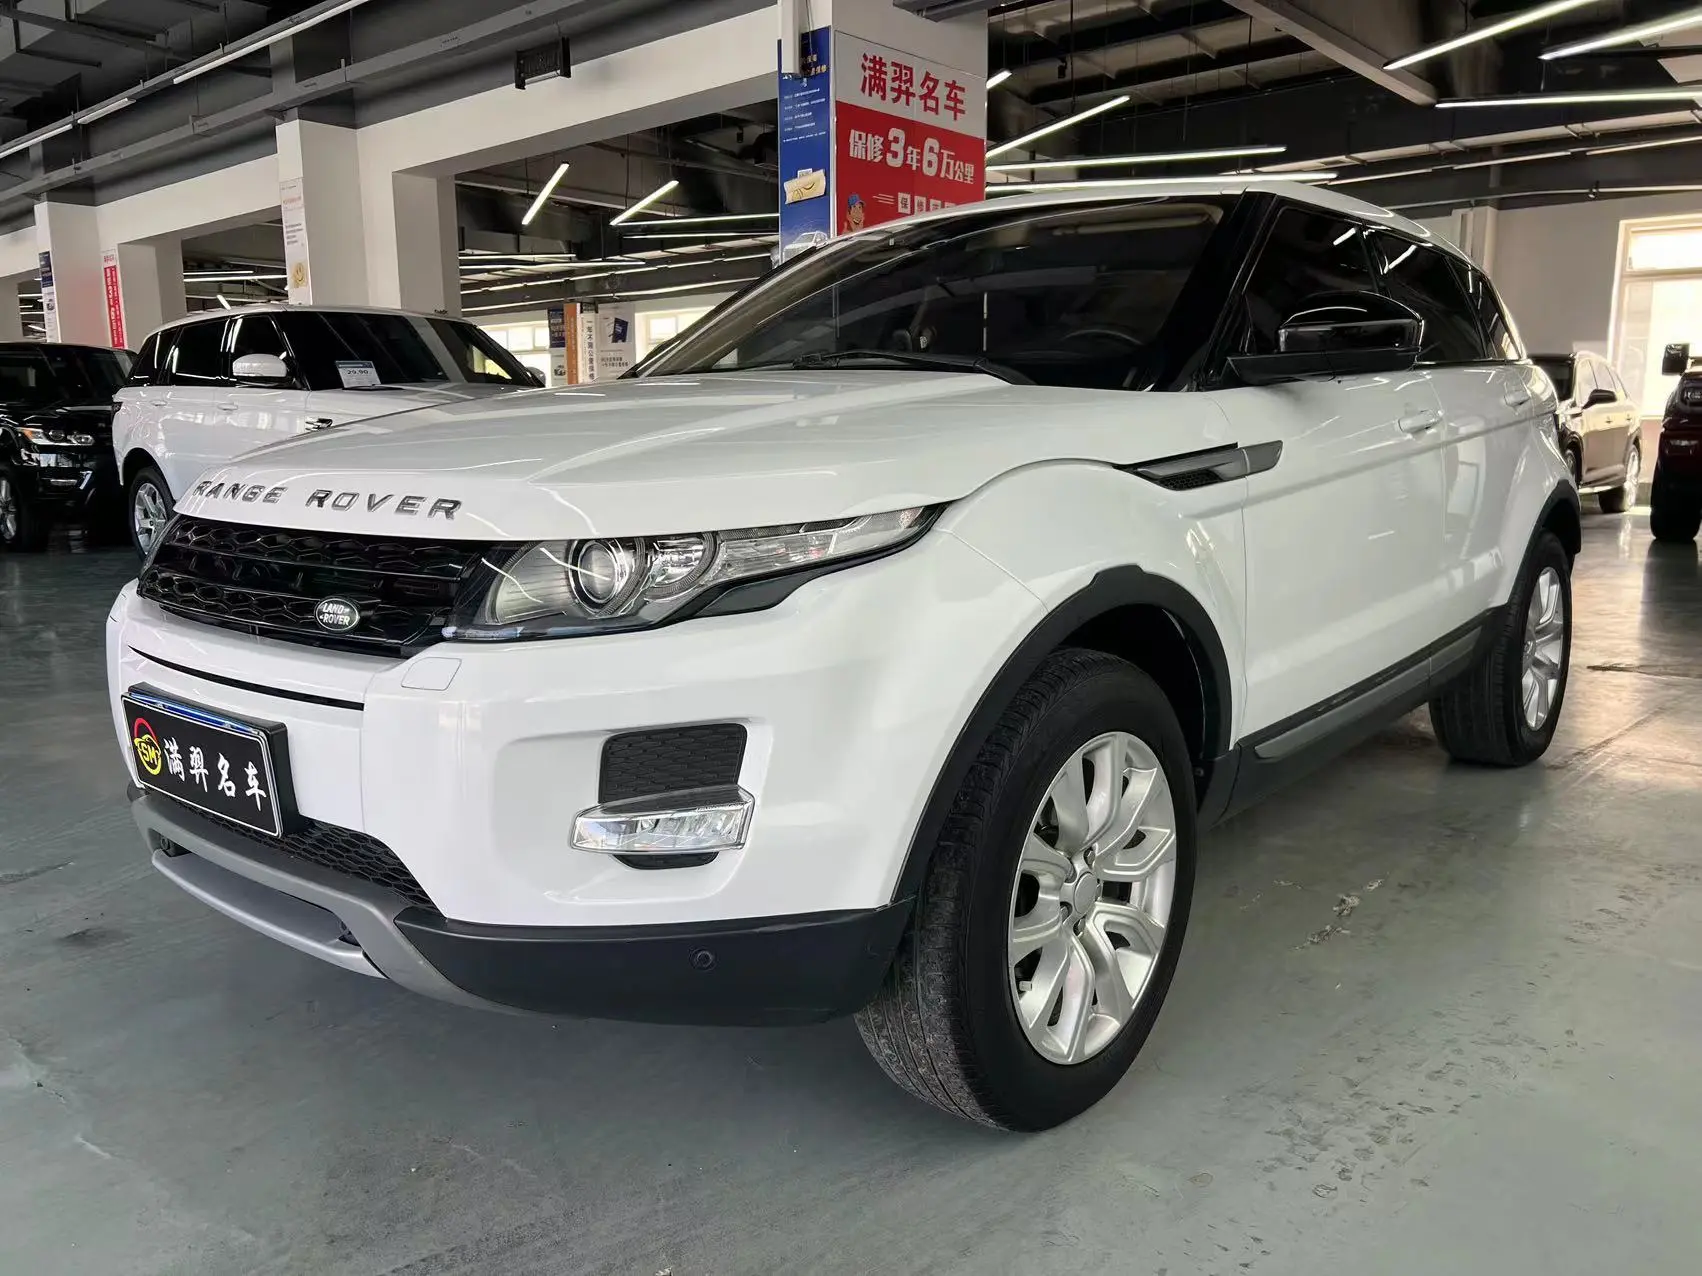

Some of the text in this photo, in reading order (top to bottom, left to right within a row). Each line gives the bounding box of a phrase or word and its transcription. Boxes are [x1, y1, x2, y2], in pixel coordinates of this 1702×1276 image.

[860, 52, 966, 121] 满羿名车
[849, 127, 975, 185] 保修3年6万公里
[192, 480, 463, 520] RANGE ROVER
[322, 612, 351, 626] ROVER
[323, 602, 345, 614] LAND
[140, 742, 158, 766] SM
[163, 737, 267, 812] 满羿名车
